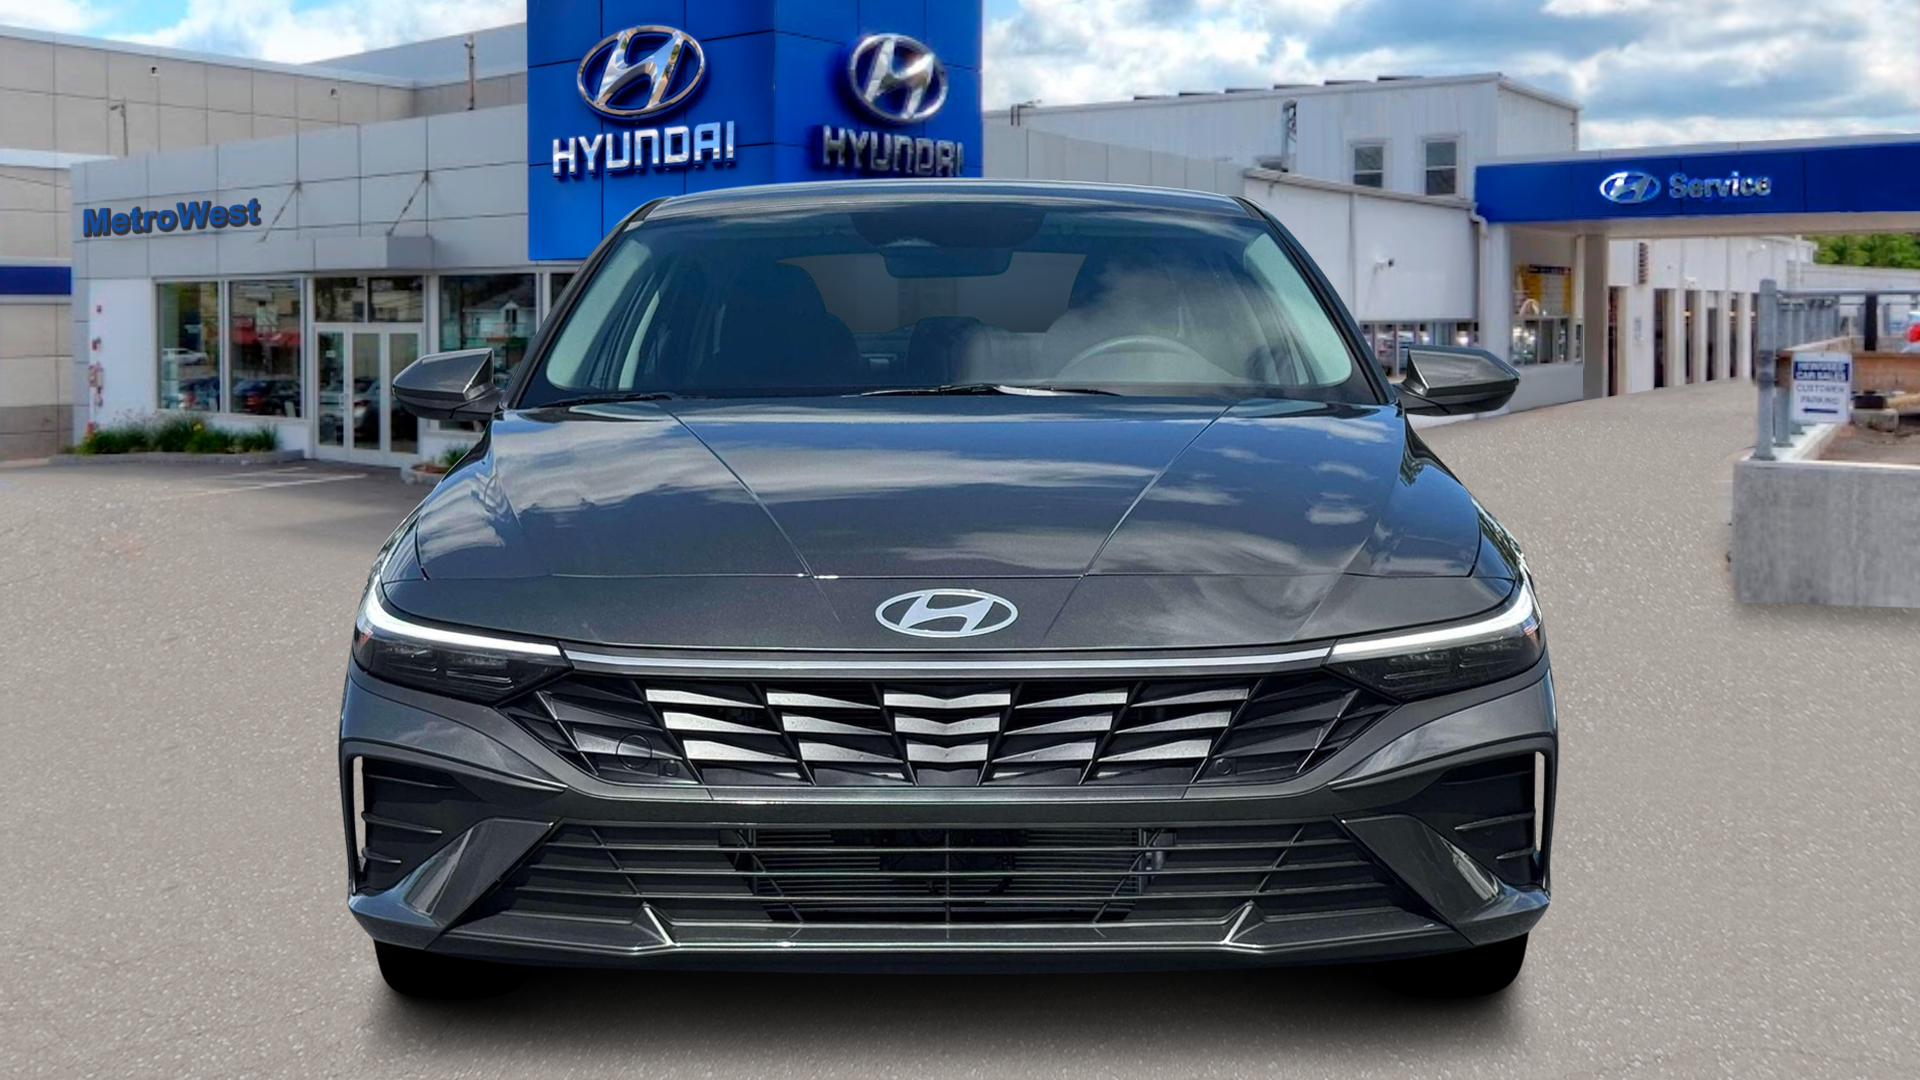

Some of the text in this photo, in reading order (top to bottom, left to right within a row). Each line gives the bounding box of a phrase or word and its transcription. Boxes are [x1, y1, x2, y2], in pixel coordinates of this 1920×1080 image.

[552, 120, 736, 176] HYUNDAI
[822, 124, 965, 177] HYUNDAI
[1669, 171, 1772, 199] Service
[83, 198, 262, 237] MetroWest
